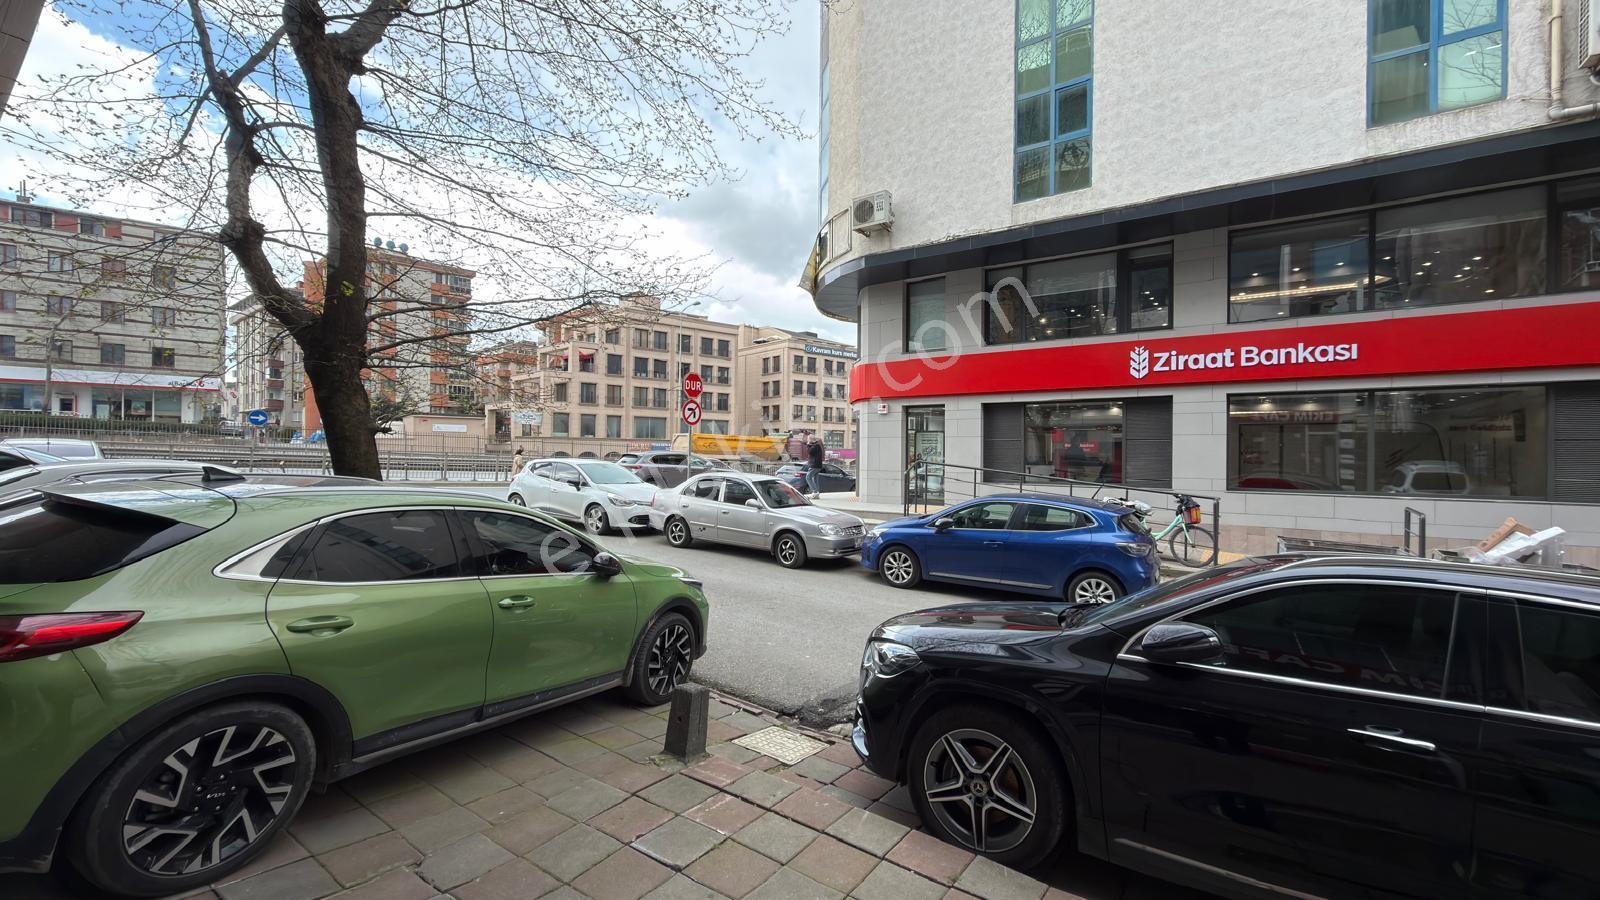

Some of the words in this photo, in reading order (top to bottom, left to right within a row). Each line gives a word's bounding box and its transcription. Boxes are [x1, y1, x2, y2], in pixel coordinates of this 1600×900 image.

[1153, 348, 1235, 372] Ziraat
[1240, 343, 1358, 367] Bankası
[685, 380, 702, 391] DUR
